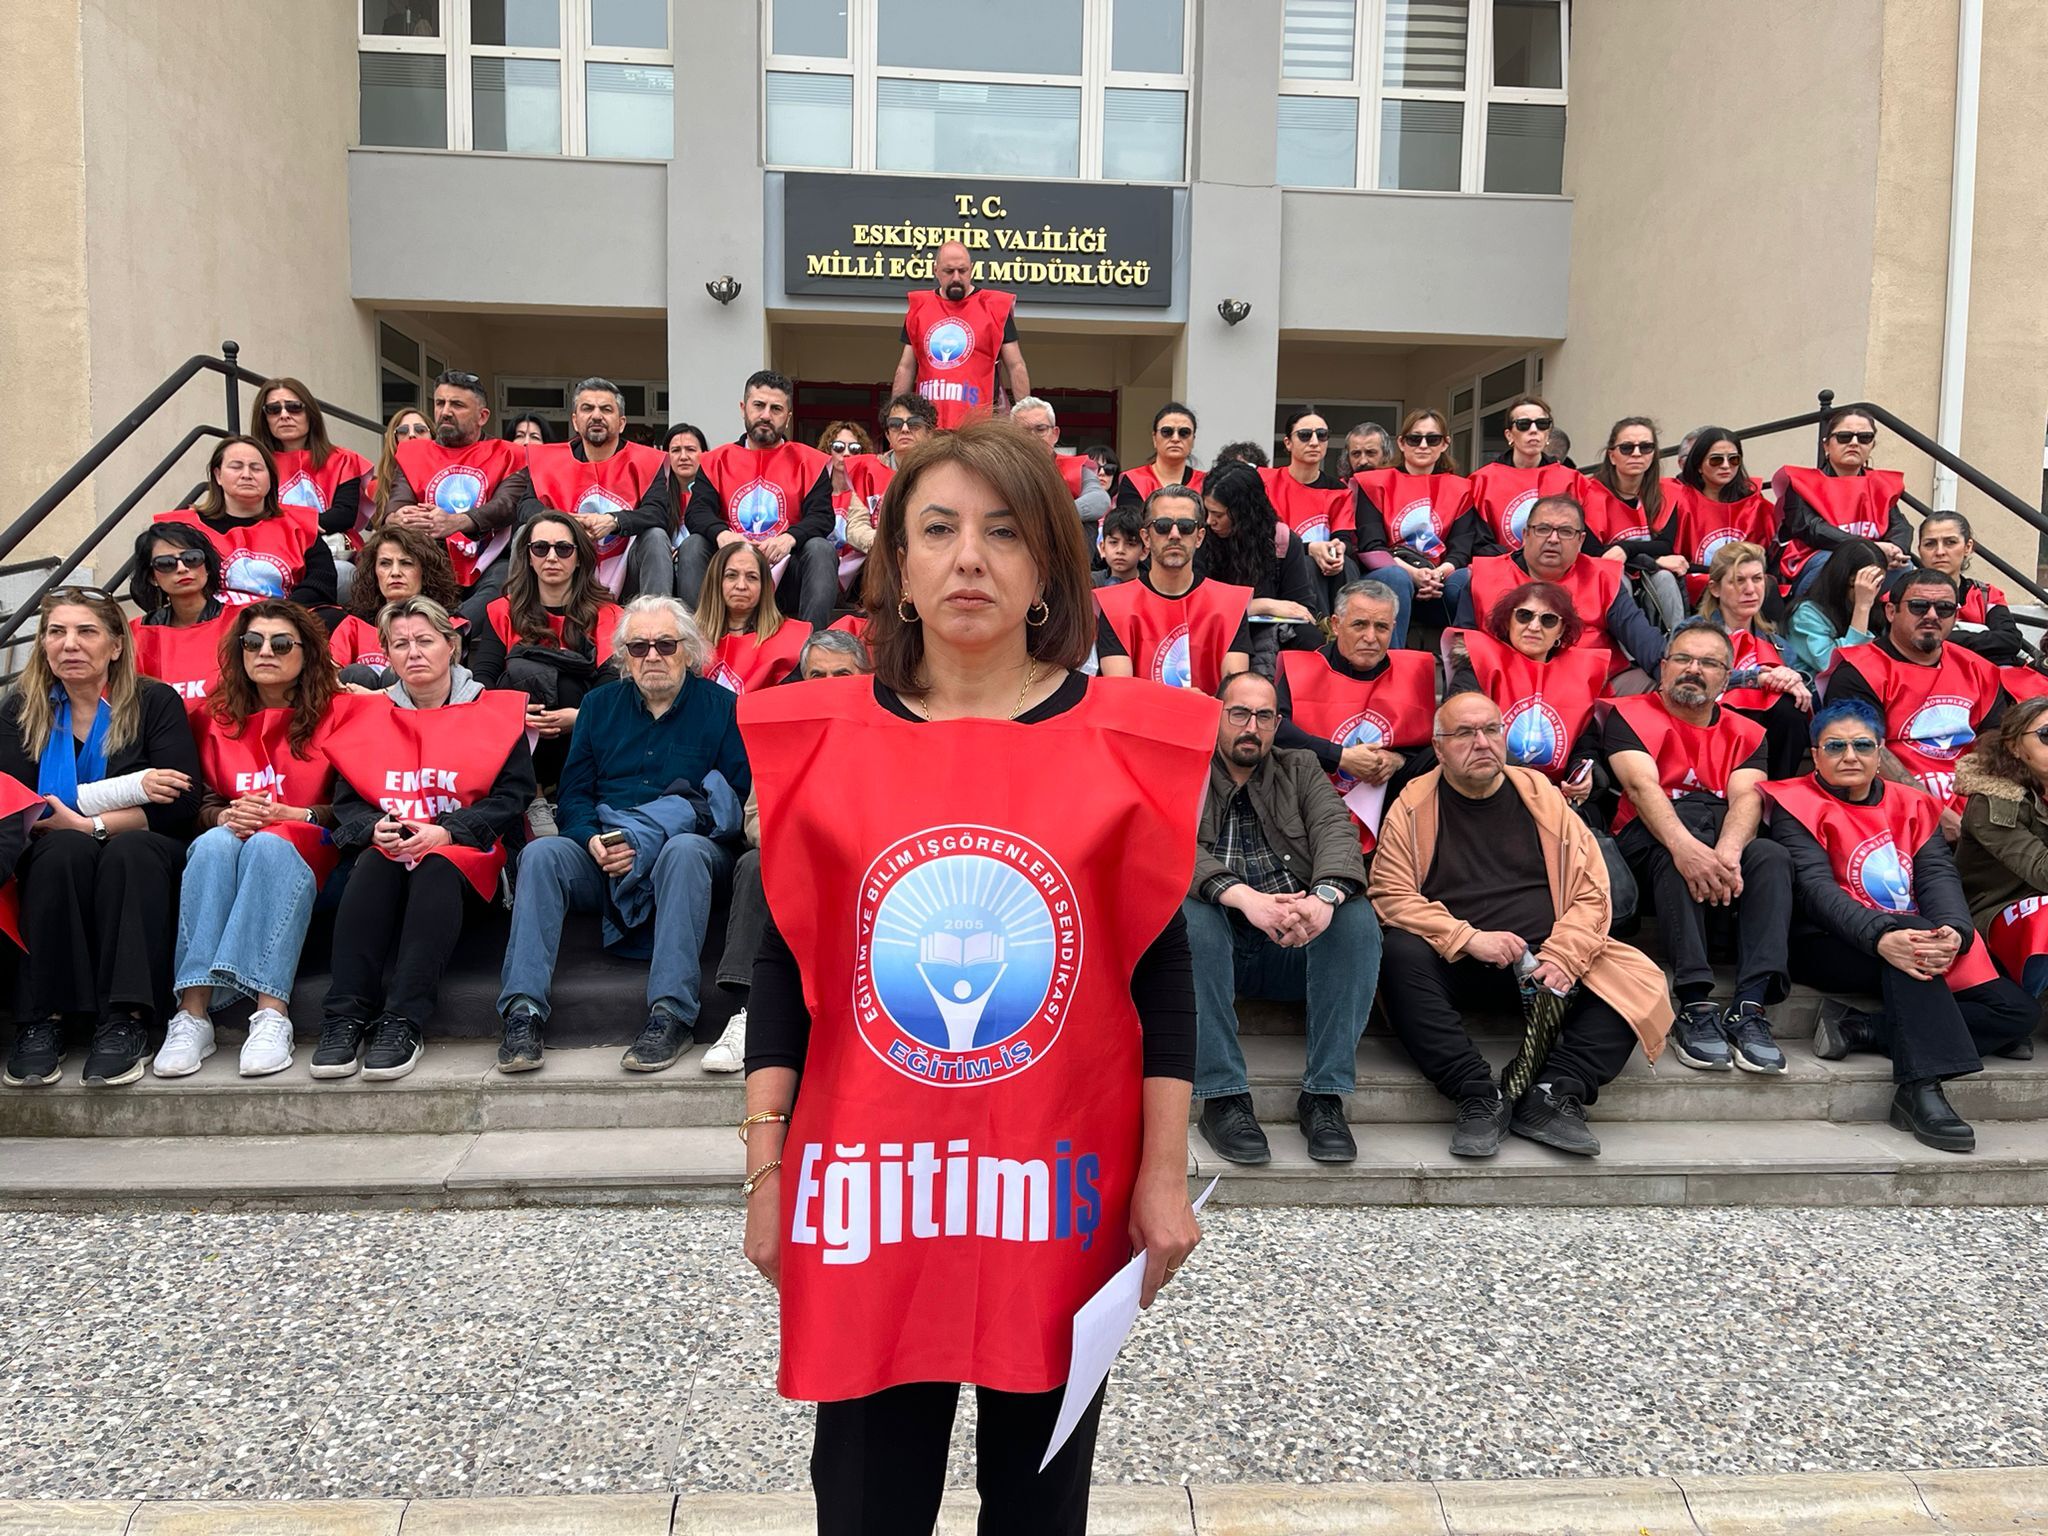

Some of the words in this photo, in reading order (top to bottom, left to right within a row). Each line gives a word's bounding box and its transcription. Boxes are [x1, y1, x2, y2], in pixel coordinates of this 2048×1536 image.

[955, 195, 978, 216] T.
[982, 196, 1007, 218] C.
[853, 219, 991, 251] ESKİŞEHİR
[994, 225, 1107, 253] VALİLİĞİ
[807, 250, 885, 278] MİLLÎ
[889, 252, 985, 280] EĞİM
[989, 256, 1151, 287] MÜDÜRLÜĞÜ
[867, 849, 914, 903] BİLİM
[916, 832, 1064, 897] İŞGÖRENLERİ
[862, 908, 873, 936] VE
[943, 919, 984, 930] 2005
[1043, 900, 1075, 1025] SENDİKASI
[856, 944, 880, 1024] EĞİTİM
[887, 1038, 1034, 1081] EĞİTİM-İŞ
